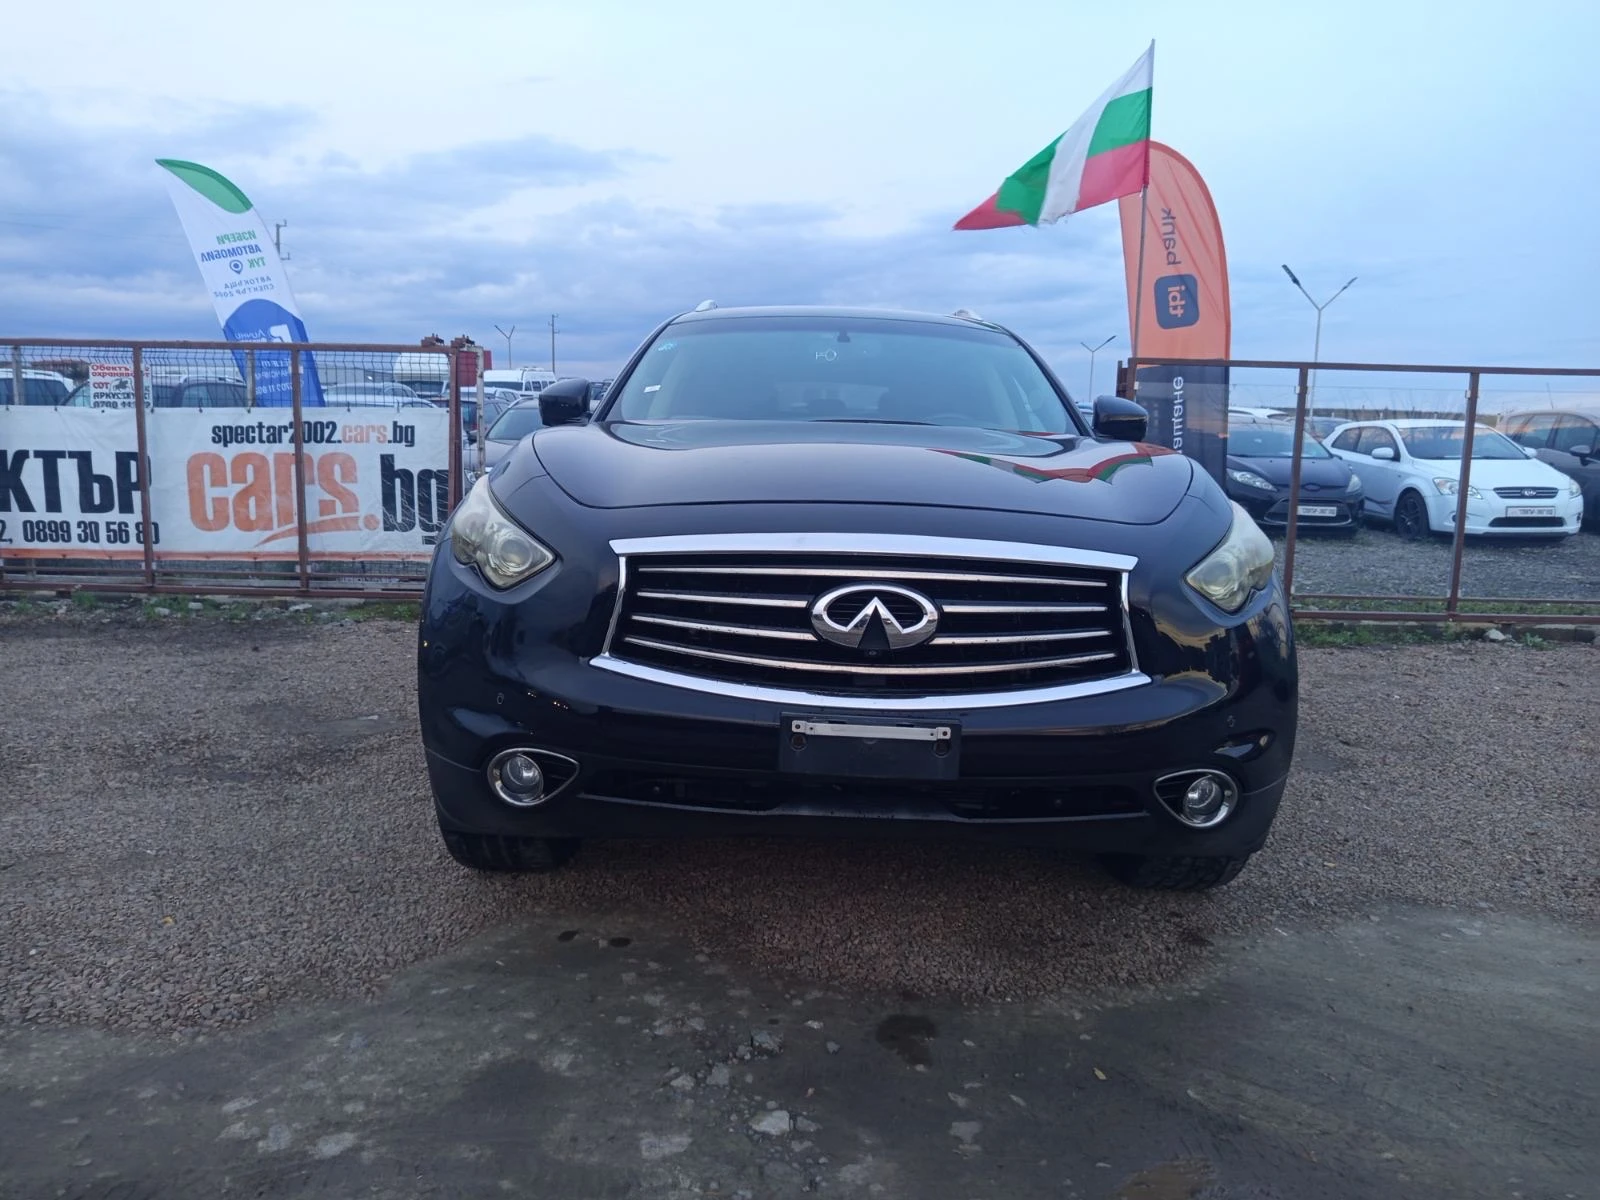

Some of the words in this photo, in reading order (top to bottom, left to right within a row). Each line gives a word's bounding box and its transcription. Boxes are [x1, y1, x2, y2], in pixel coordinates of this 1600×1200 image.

[22, 519, 72, 543] 0899
[76, 520, 100, 543] 30
[105, 521, 130, 544] 56
